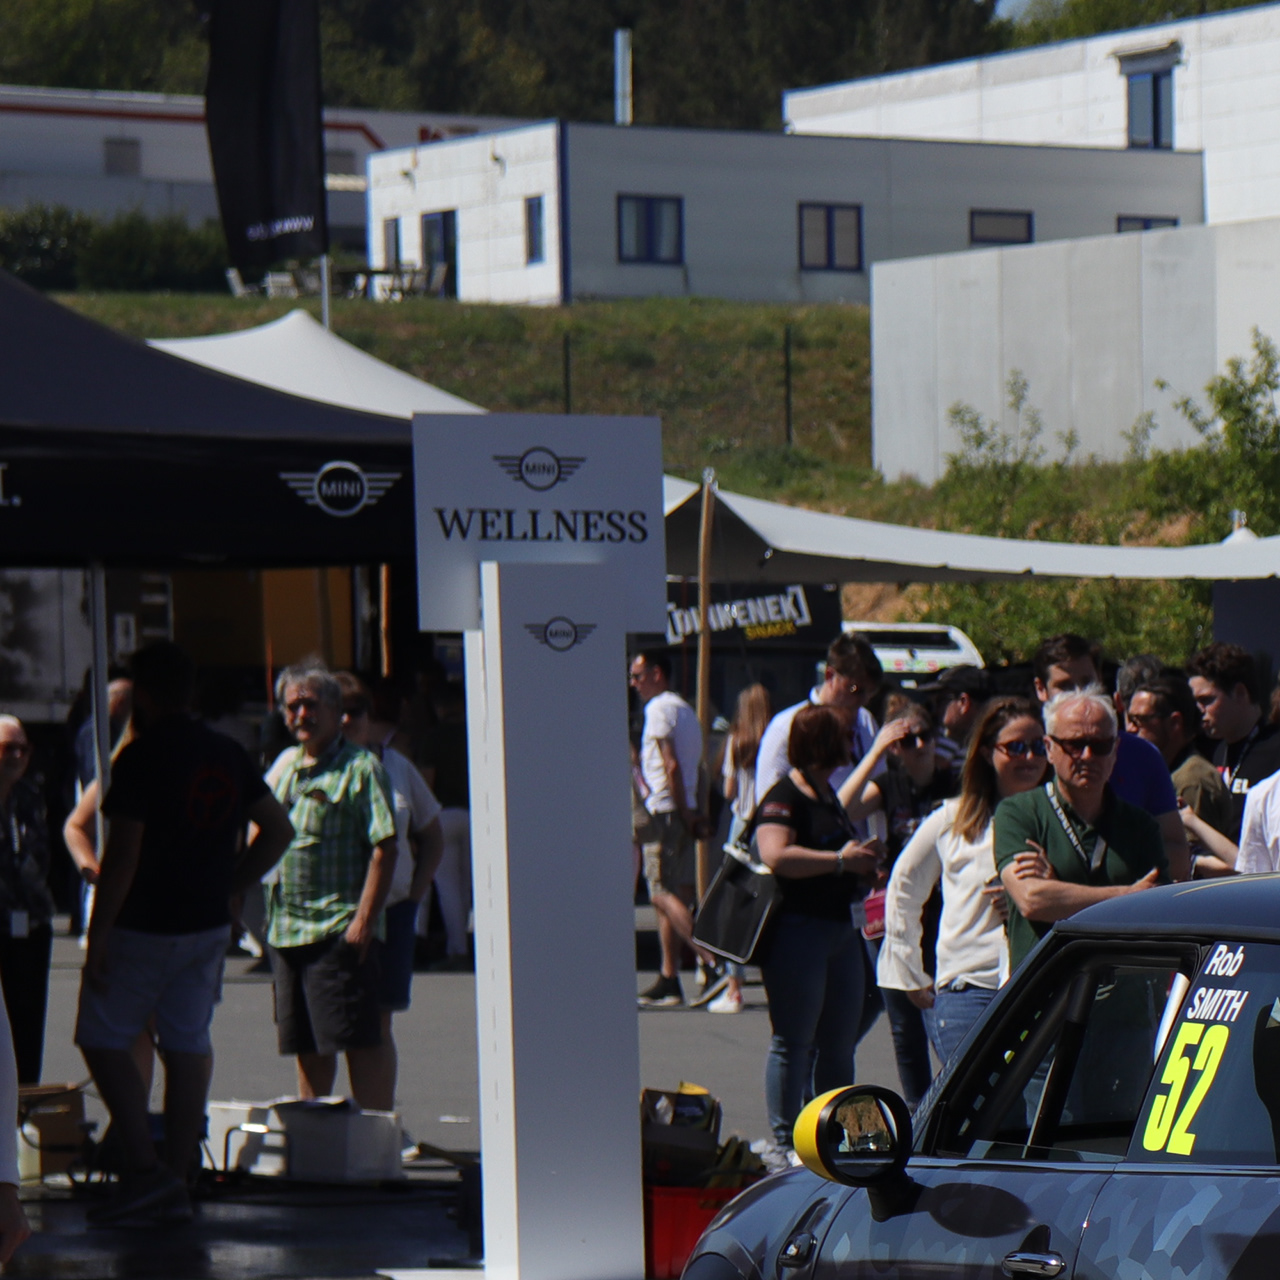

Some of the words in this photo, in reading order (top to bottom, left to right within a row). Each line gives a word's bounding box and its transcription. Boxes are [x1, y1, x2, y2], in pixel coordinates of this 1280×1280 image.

[525, 463, 556, 475] MINI
[321, 481, 361, 497] MINI
[433, 507, 648, 543] WELLNESS
[549, 629, 573, 640] MINI
[1205, 945, 1245, 977] Rob
[1187, 988, 1248, 1022] SMITH
[1143, 1022, 1229, 1156] 52
